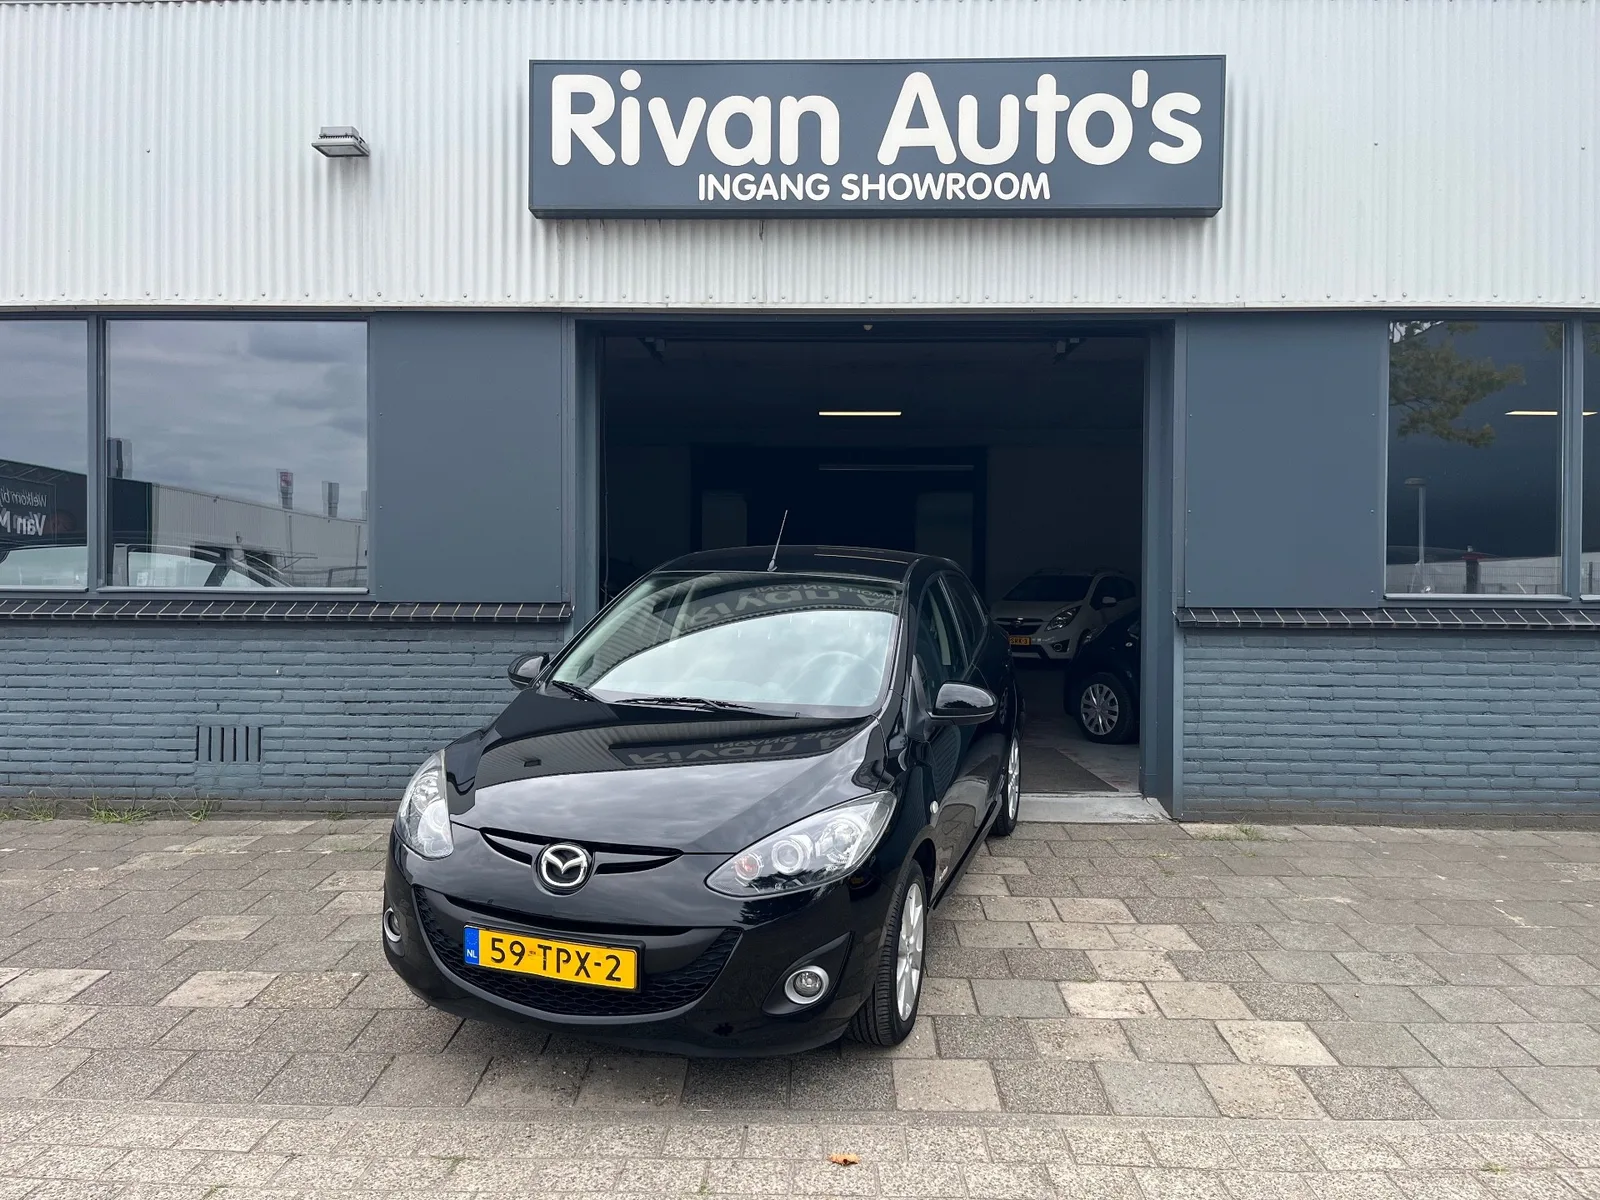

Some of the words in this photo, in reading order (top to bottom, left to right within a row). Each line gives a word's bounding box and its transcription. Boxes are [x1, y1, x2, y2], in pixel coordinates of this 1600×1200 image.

[551, 69, 840, 166] Rivan
[877, 69, 1202, 166] Auto's
[698, 172, 831, 201] INGANG
[841, 172, 1051, 201] SHOWROOM
[466, 948, 478, 959] NL
[491, 938, 621, 982] 59-TPX-2
